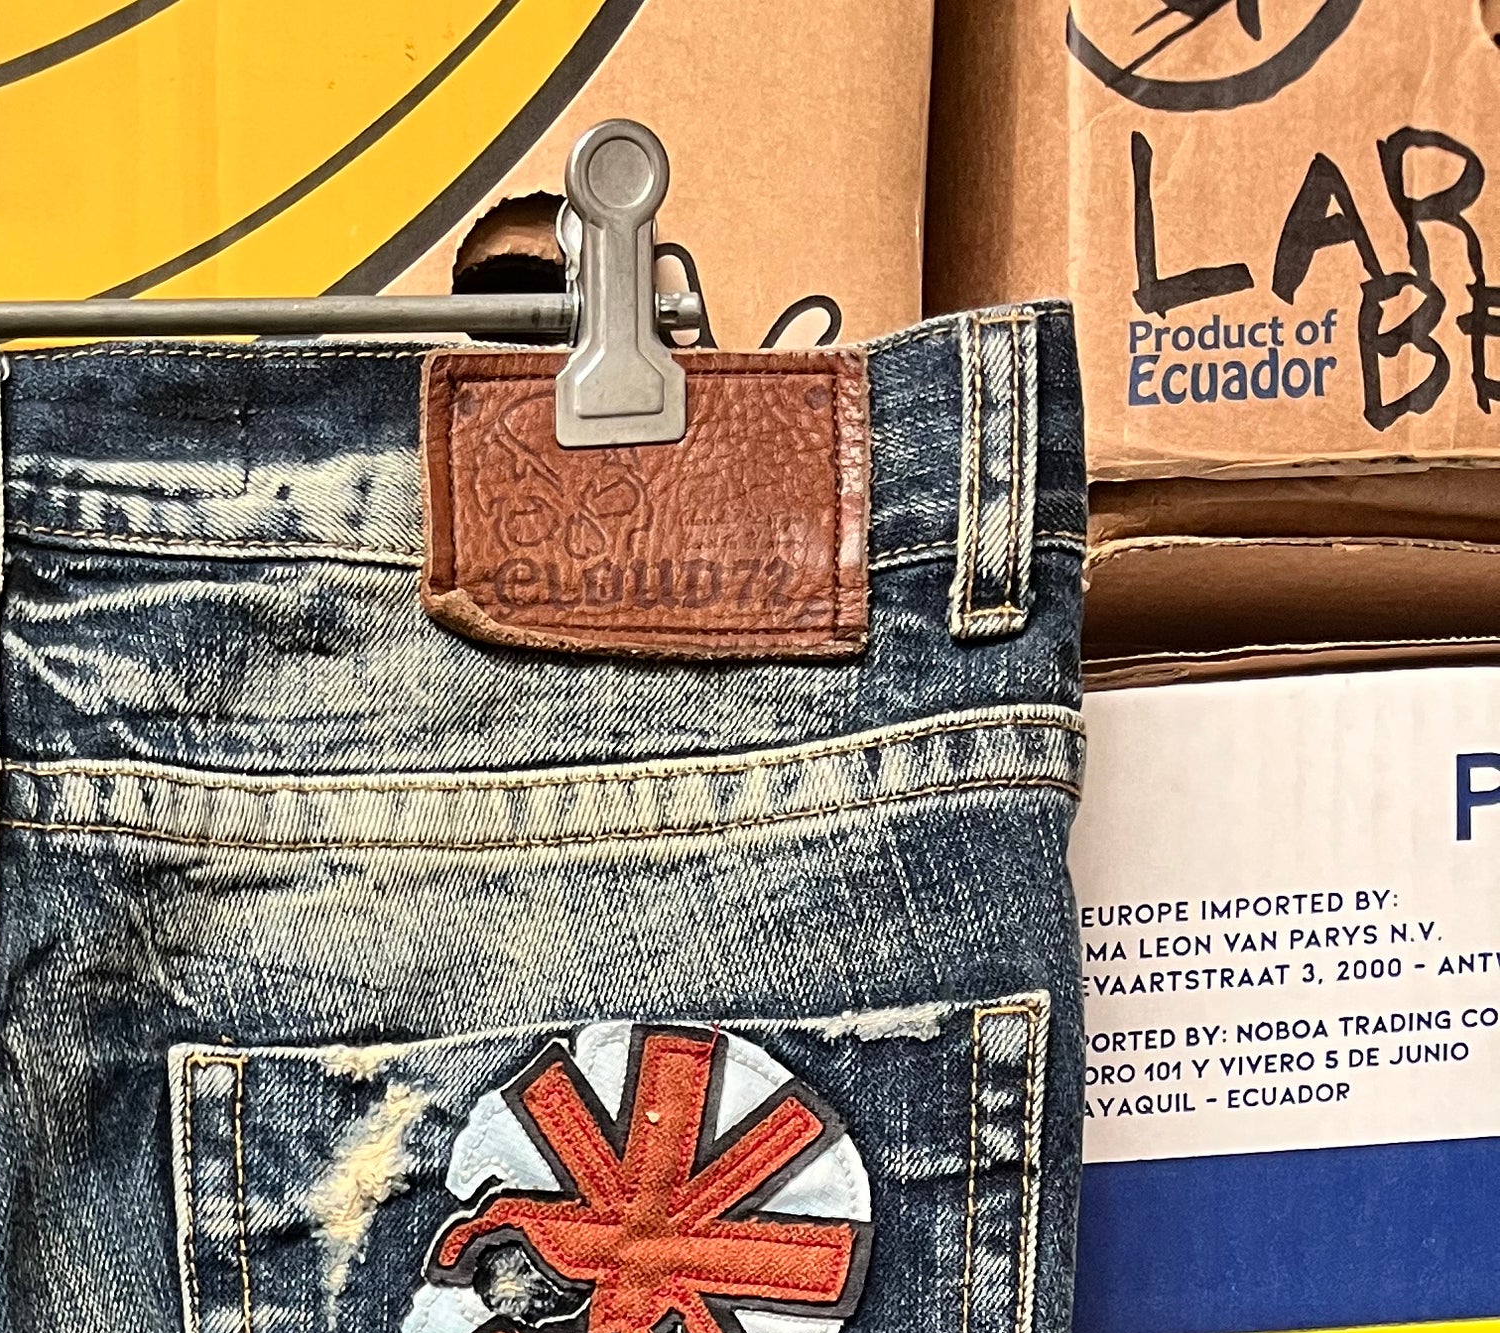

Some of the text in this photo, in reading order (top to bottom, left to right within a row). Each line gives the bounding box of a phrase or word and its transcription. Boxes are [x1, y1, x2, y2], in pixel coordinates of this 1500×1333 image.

[1128, 309, 1338, 354] Product of
[1128, 347, 1338, 406] Ecuador
[1081, 889, 1398, 928] EUROPE IMPORTED BY:
[1139, 934, 1211, 959] LEON
[1223, 930, 1277, 953] VAN
[1290, 924, 1378, 950] PARYS
[1391, 921, 1442, 943] N.V.
[1302, 962, 1323, 985] 3,
[1336, 958, 1402, 981] 2000
[1437, 951, 1500, 976] ANT
[1186, 1007, 1499, 1047] BY: NOBOA TRADING CO
[1144, 1061, 1182, 1082] 101
[1191, 1059, 1210, 1079] Y
[1219, 1051, 1315, 1077] VIVERO
[1325, 1050, 1339, 1069] 5
[1348, 1047, 1380, 1068] DE
[1389, 1042, 1469, 1065] JUNIO
[1227, 1082, 1350, 1109] ECUADOR
